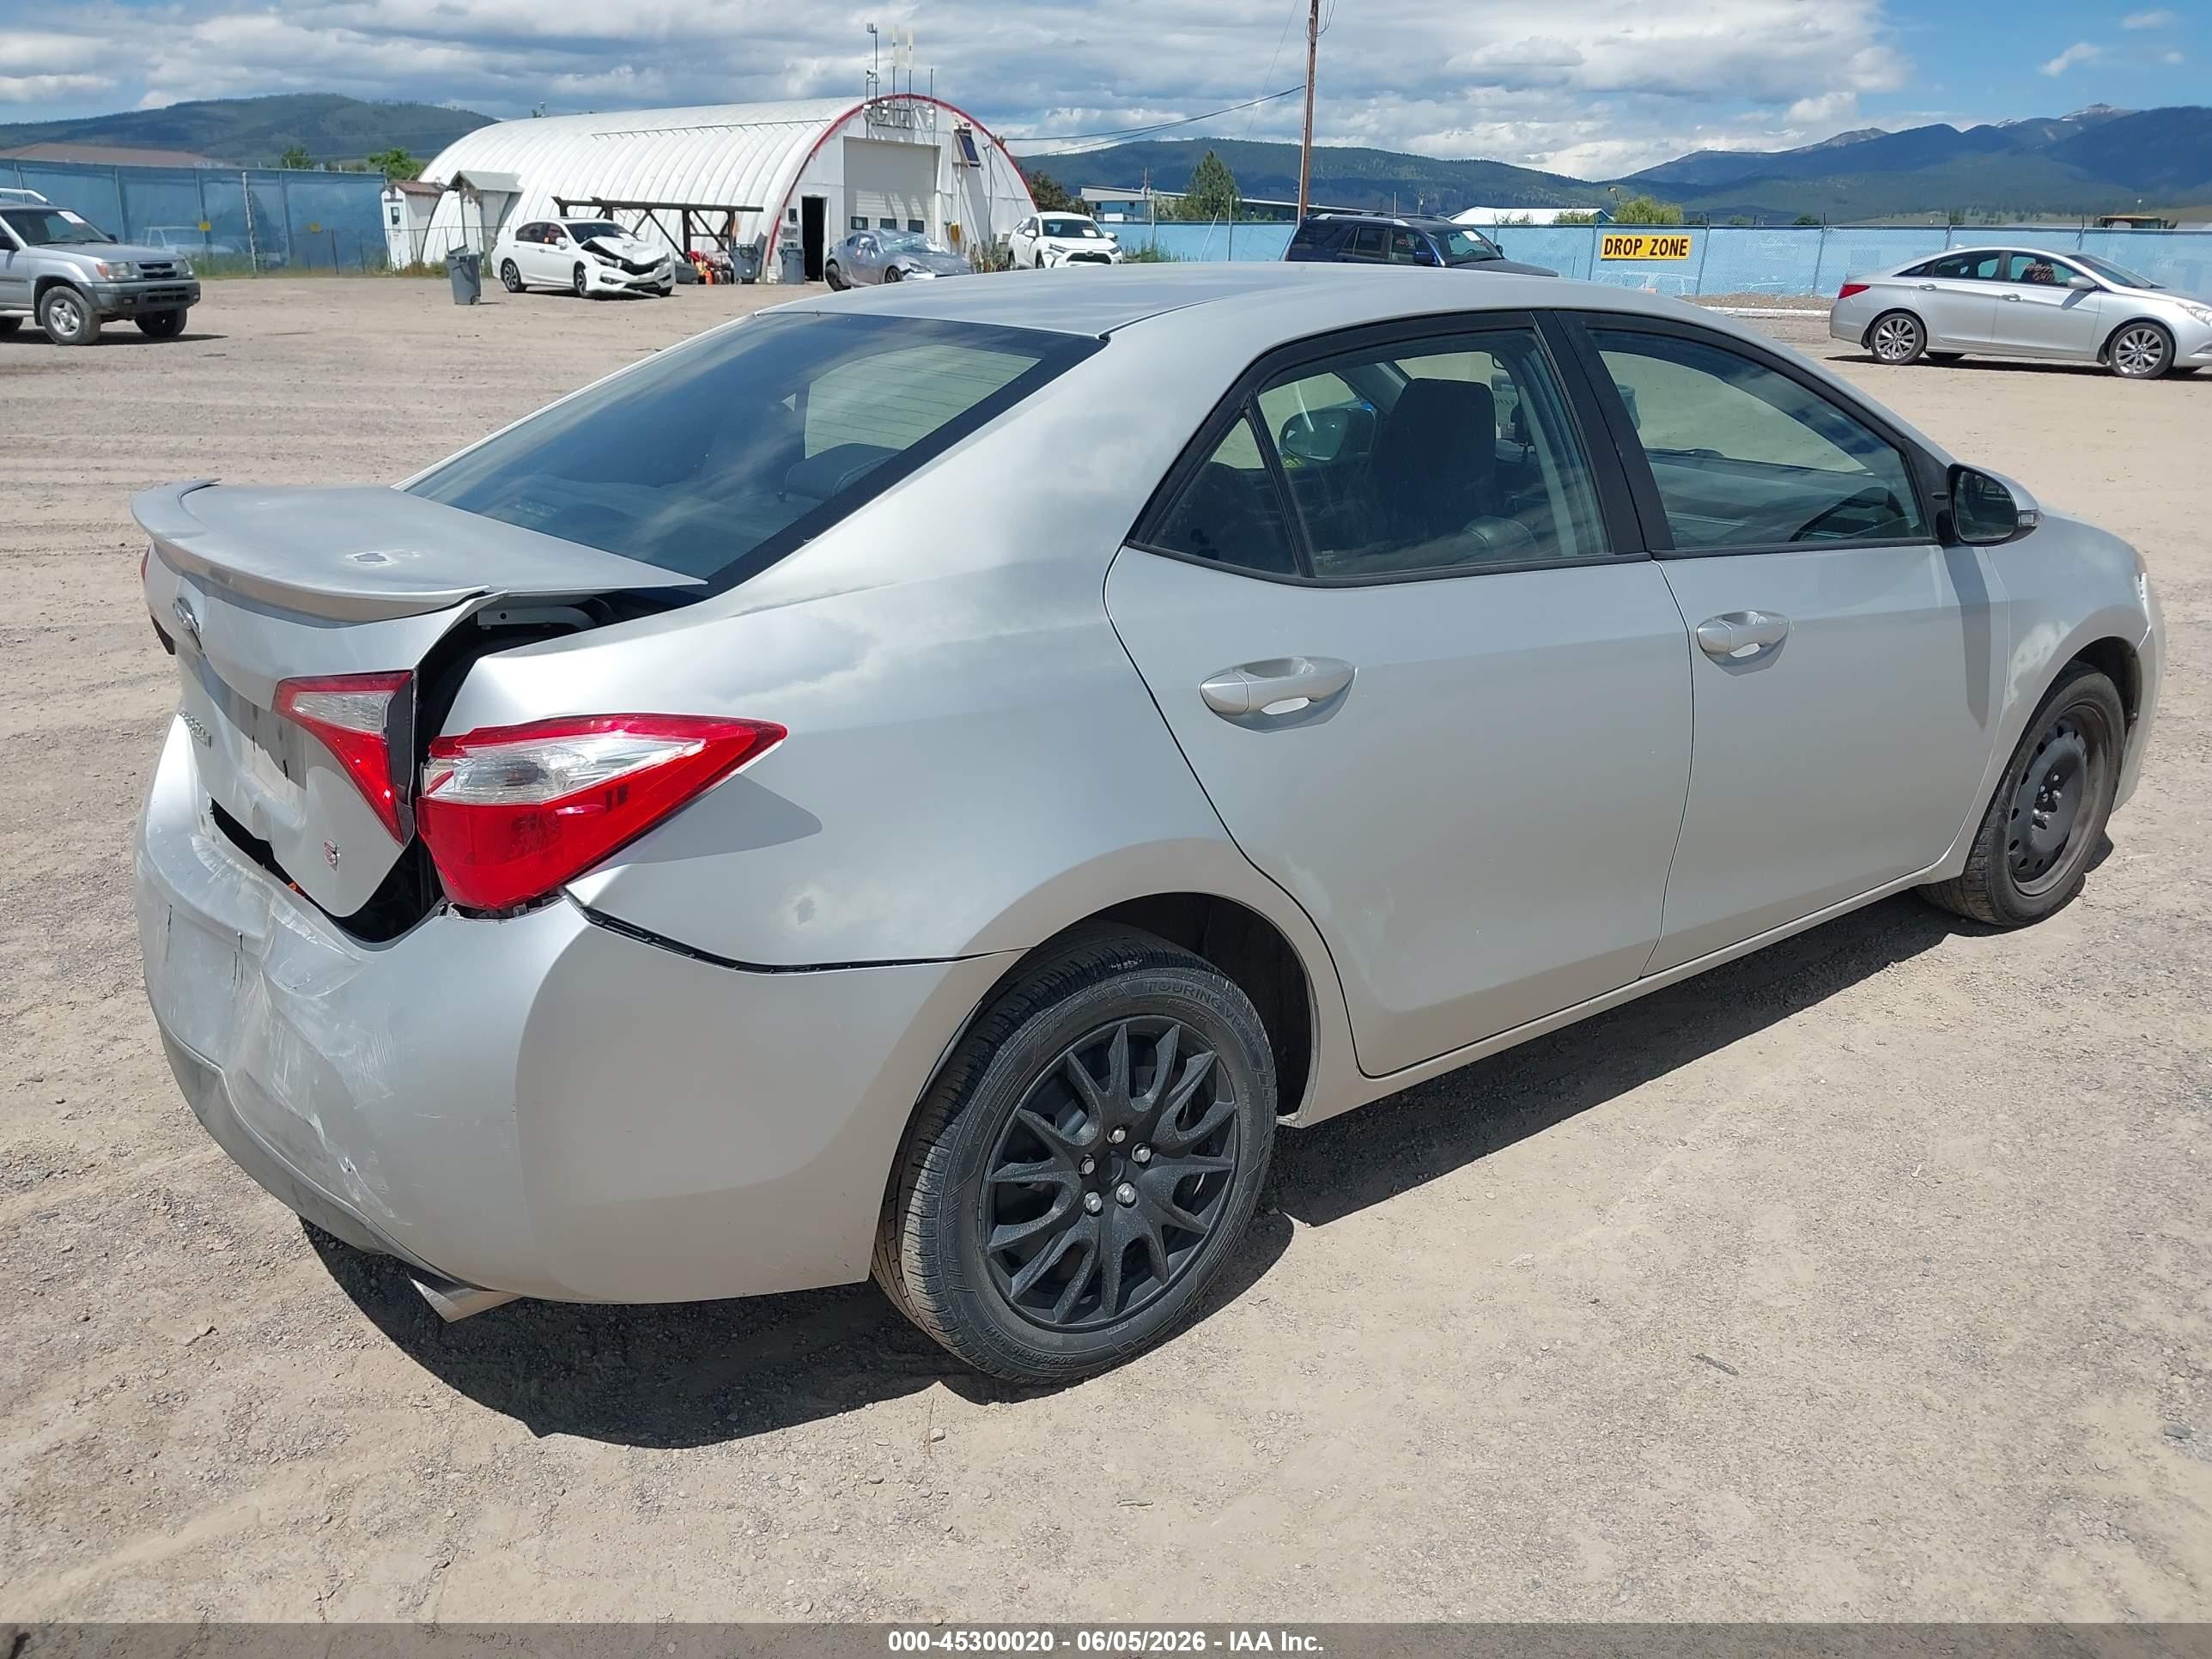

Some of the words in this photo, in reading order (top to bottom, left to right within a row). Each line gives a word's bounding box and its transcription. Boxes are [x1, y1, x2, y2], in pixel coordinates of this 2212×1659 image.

[1604, 238, 1643, 256] DROP
[1649, 238, 1689, 257] ZONE
[1145, 981, 1222, 1010] TOURING
